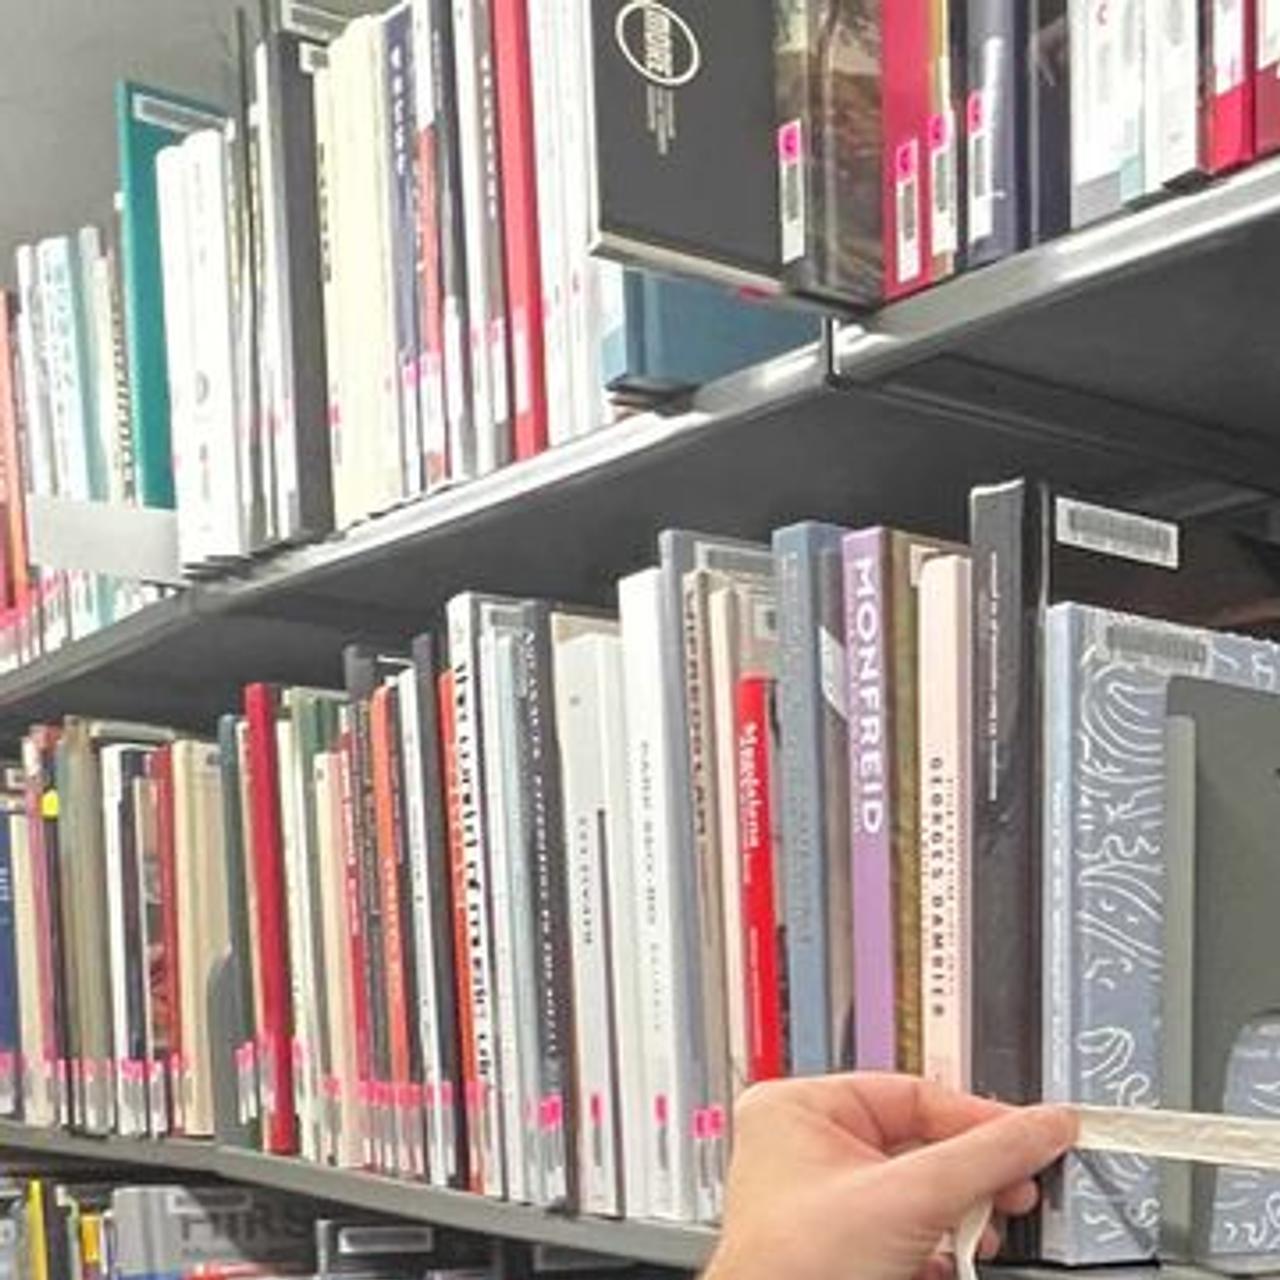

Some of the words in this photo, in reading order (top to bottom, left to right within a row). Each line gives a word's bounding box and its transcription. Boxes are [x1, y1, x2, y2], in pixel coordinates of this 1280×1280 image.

[853, 556, 883, 834] MONFREID
[930, 756, 944, 879] GEORGES
[931, 895, 945, 1018] DAMBIER
[181, 1201, 312, 1243] HIRS
